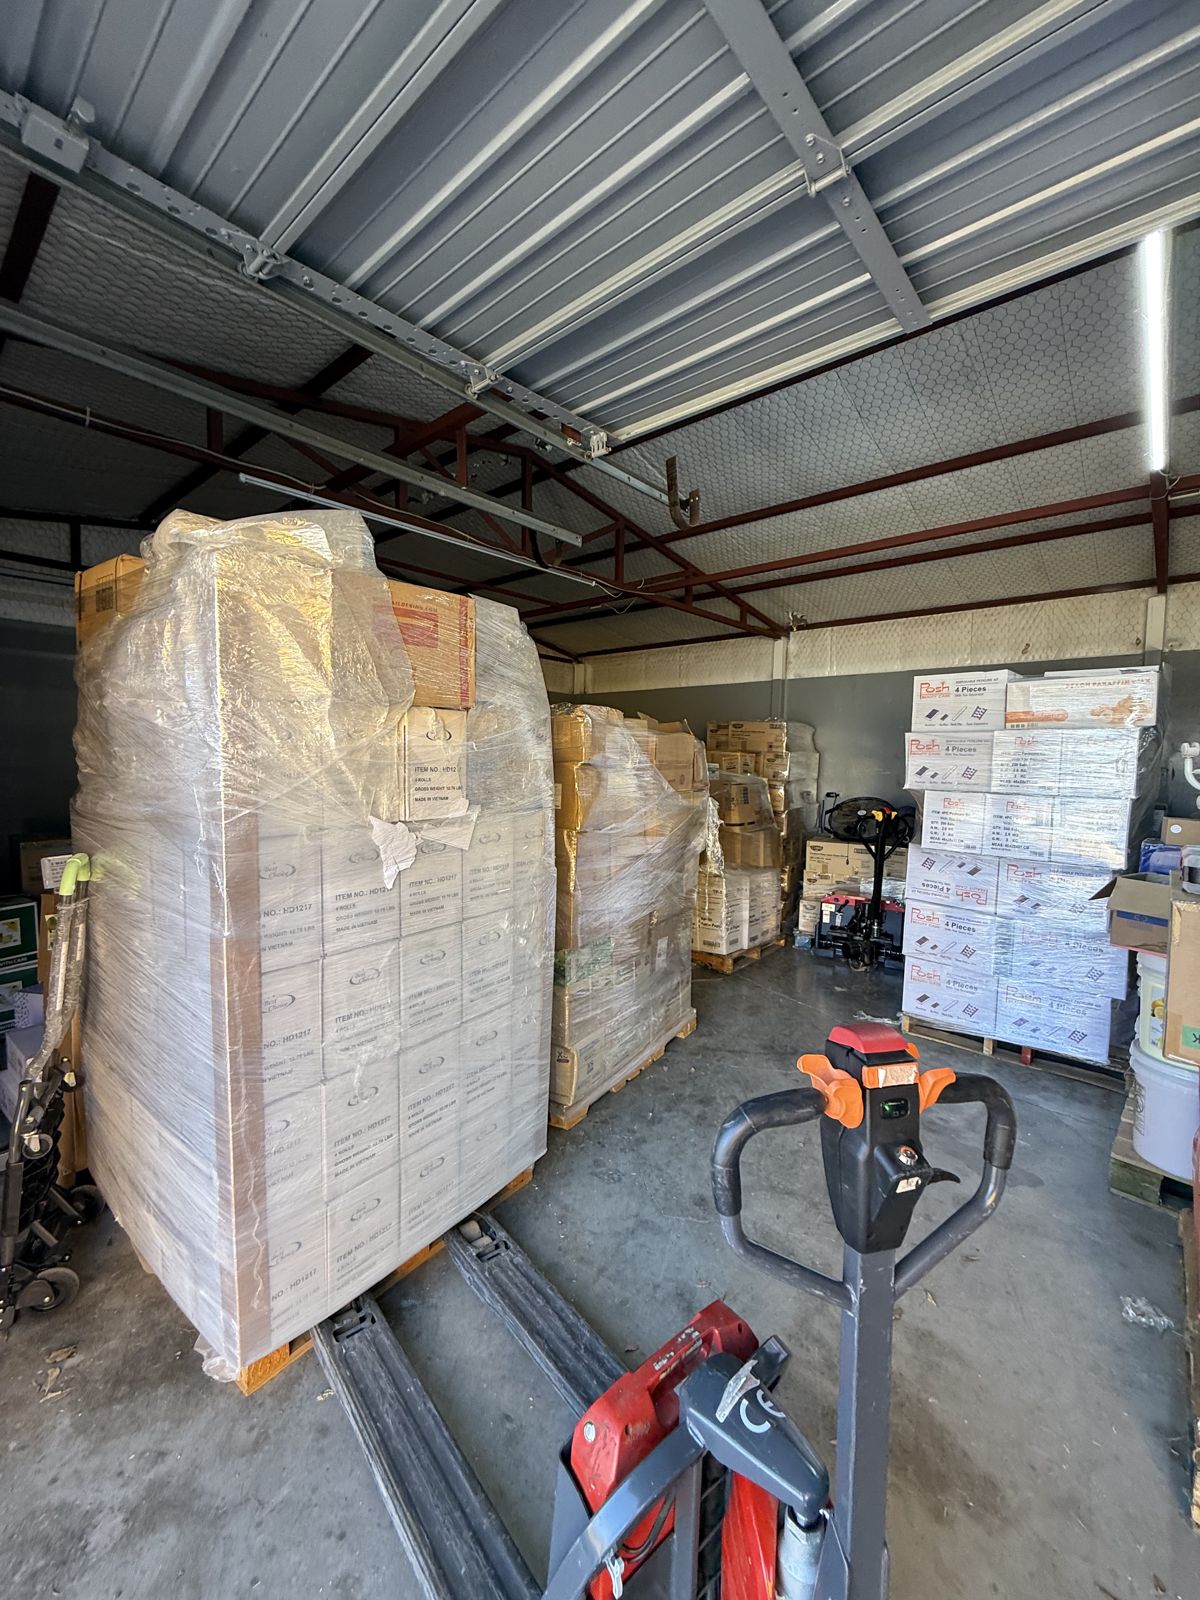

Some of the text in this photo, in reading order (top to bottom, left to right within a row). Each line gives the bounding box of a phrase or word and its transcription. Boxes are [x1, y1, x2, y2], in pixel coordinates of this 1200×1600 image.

[920, 681, 950, 696] Posh
[961, 685, 987, 693] Pieces
[911, 739, 940, 753] Posh
[408, 879, 423, 888] ITEM
[921, 882, 944, 892] Pieces
[335, 890, 368, 901] ITEM NO.:
[263, 903, 313, 918] NO.: HD1217
[911, 907, 940, 921] Posh
[357, 919, 378, 929] VIETNAM
[951, 922, 976, 933] Pieces
[267, 941, 294, 952] VIETNAM
[952, 980, 978, 992] Pieces
[263, 1028, 312, 1050] NO.: HD1217
[407, 1100, 422, 1112] ITEM
[435, 1082, 455, 1097] HD1217
[334, 1135, 351, 1148] ITEM
[367, 1115, 391, 1131] HD1217
[336, 1249, 353, 1263] ITEM
[289, 1267, 318, 1290] HD1217
